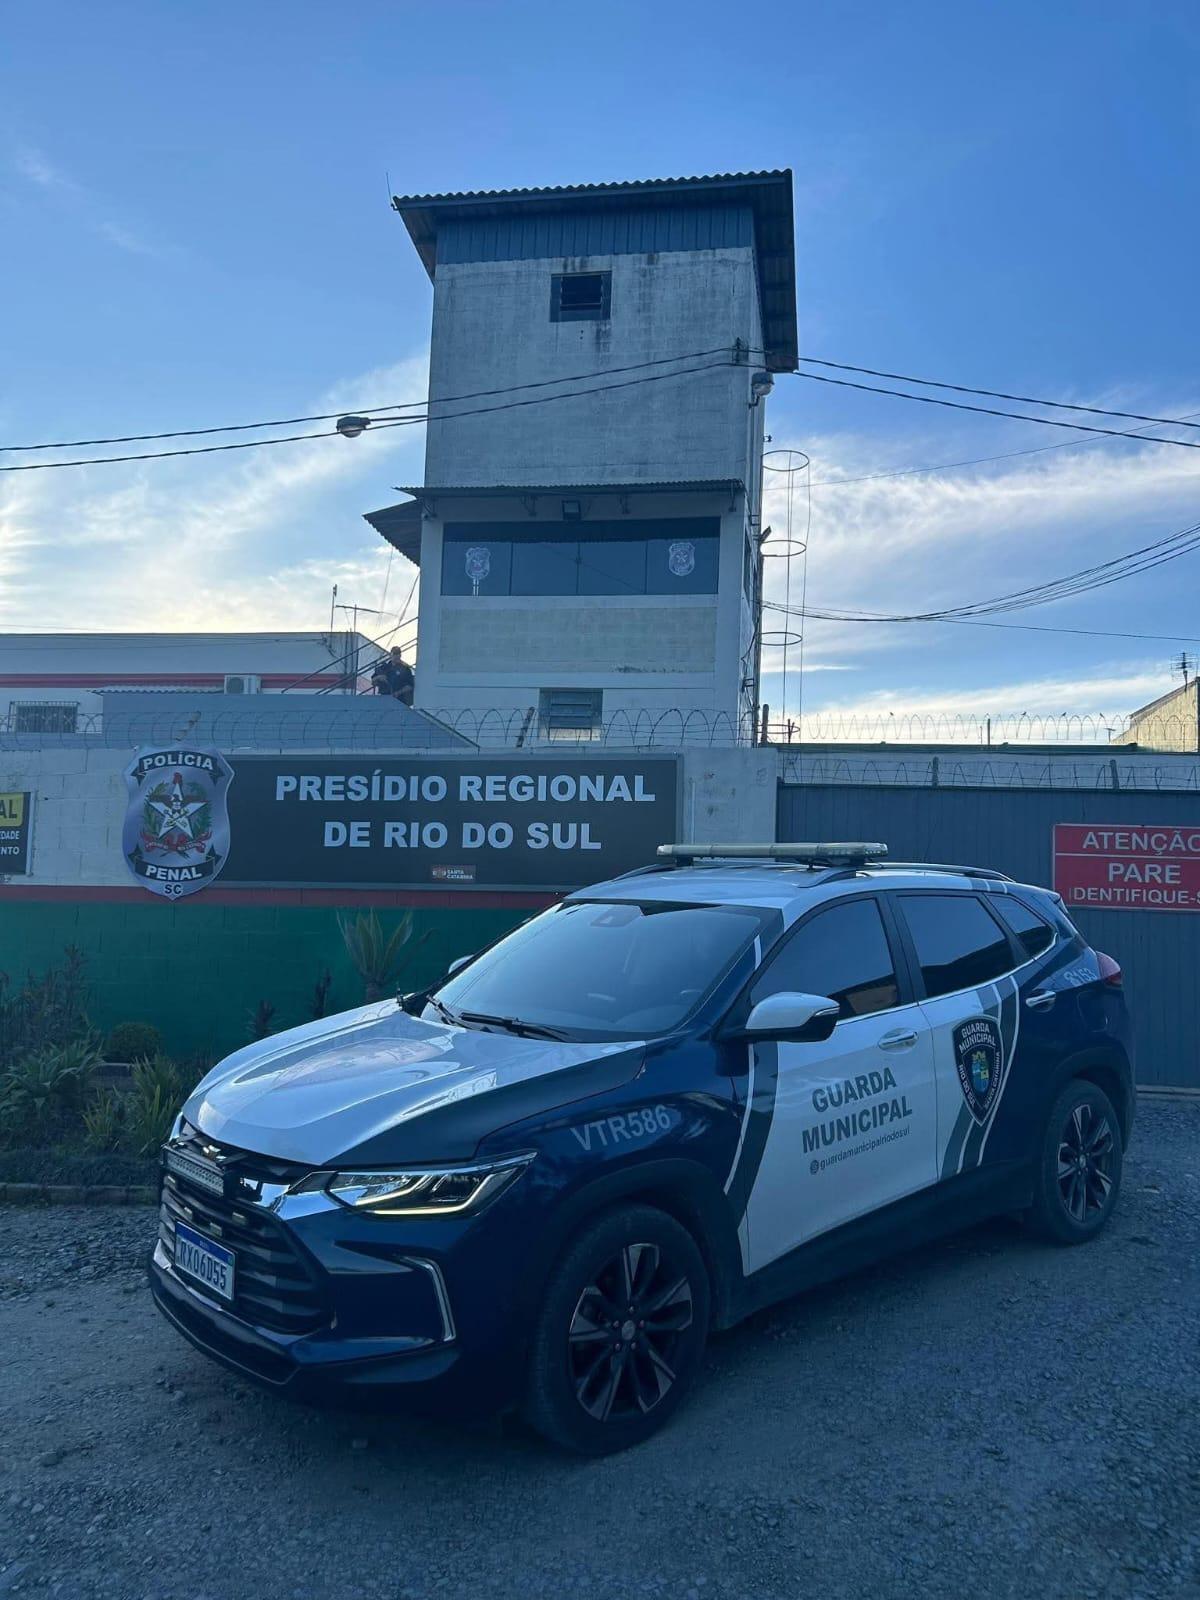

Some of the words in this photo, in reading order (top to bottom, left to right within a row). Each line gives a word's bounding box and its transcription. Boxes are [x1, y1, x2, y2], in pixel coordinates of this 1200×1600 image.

[143, 752, 214, 770] POLÍCIA
[275, 769, 448, 802] PRESÍDIO
[459, 774, 656, 802] REGIONAL
[323, 821, 371, 848] DE
[384, 821, 448, 849] RIO
[462, 822, 514, 849] DO
[526, 822, 602, 850] SUL
[146, 865, 202, 881] PENAL
[1108, 862, 1182, 884] PARE
[164, 884, 182, 895] SC
[961, 1022, 990, 1038] GUARDA
[958, 1033, 997, 1053] MUNICIPAL
[811, 1067, 897, 1113] GUARDA
[569, 1104, 672, 1151] VTR586
[802, 1096, 913, 1154] MUNICIPAL
